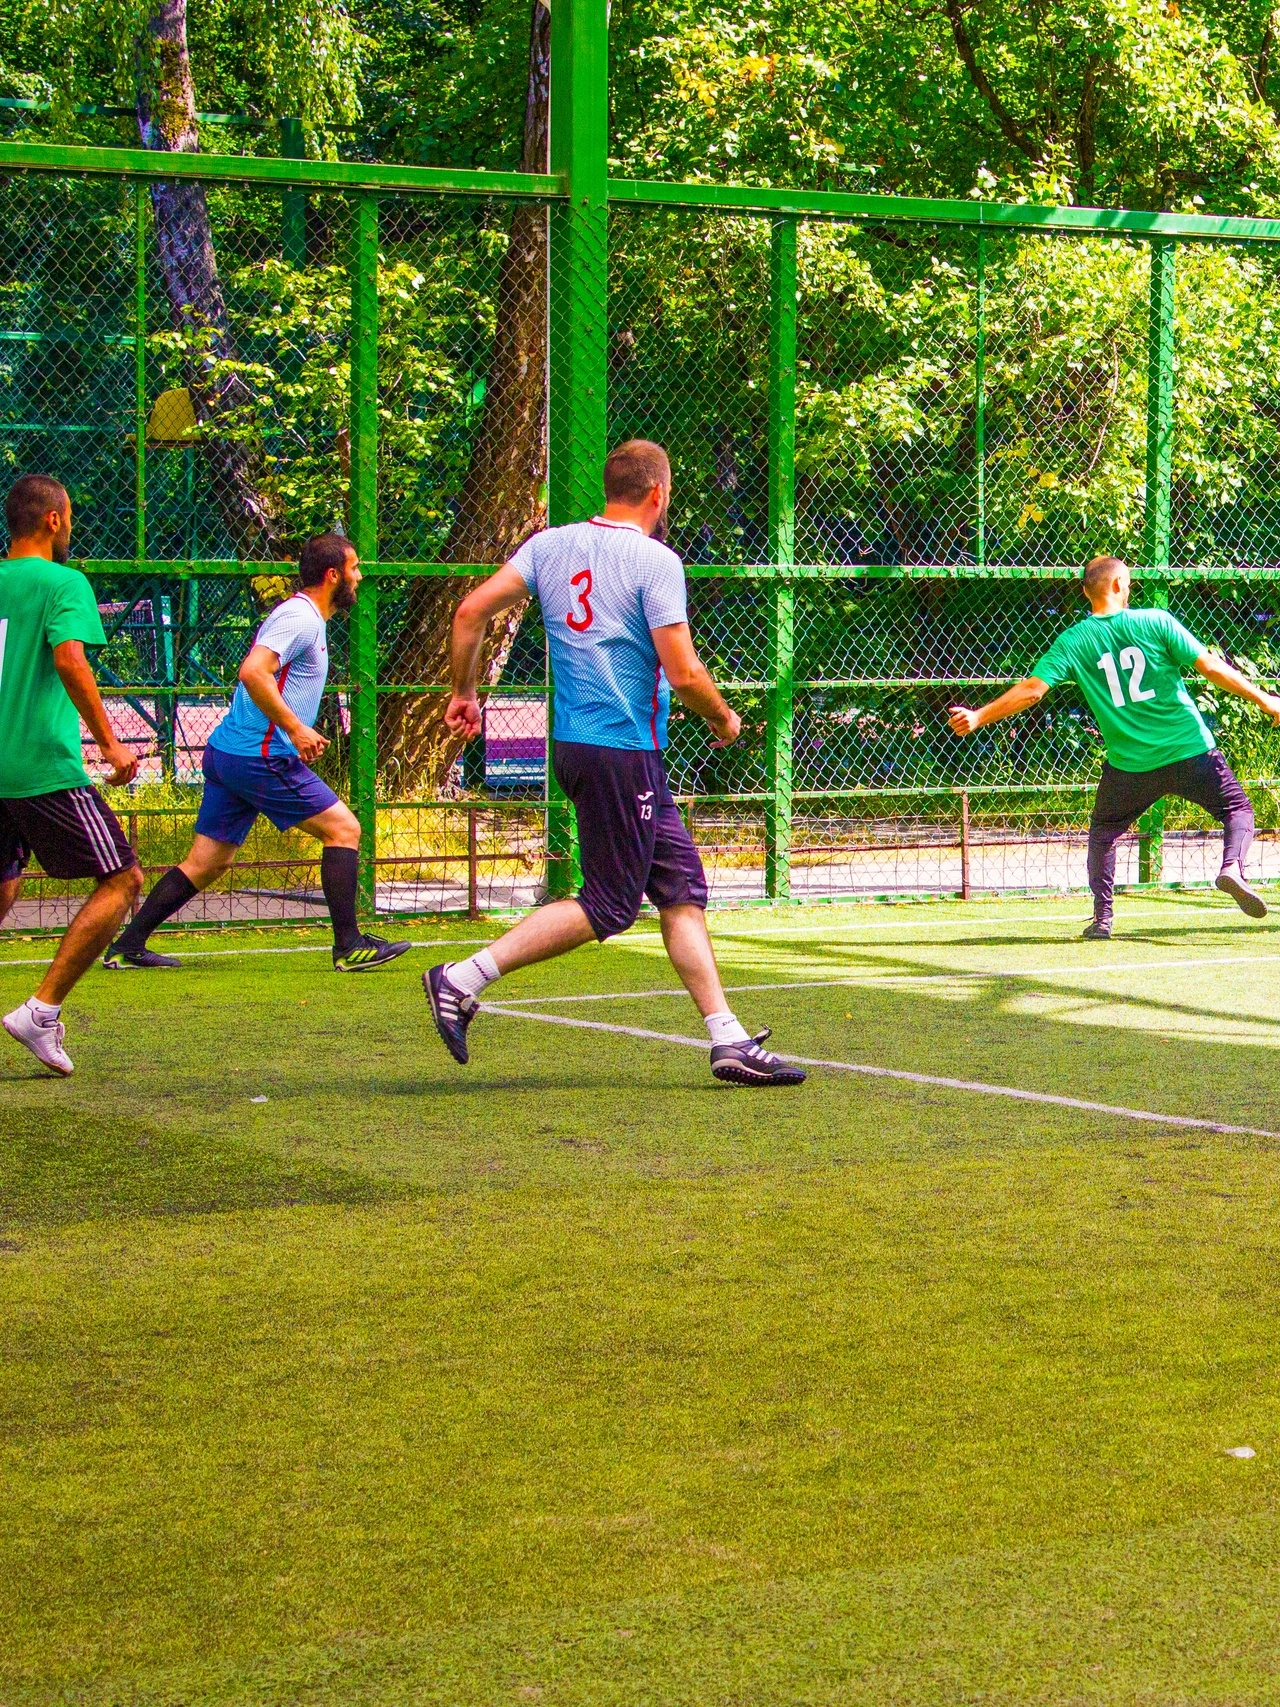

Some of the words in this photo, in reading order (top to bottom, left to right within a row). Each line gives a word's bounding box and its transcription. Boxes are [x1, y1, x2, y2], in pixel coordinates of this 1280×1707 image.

[566, 569, 593, 632] 3
[1096, 646, 1156, 708] 12
[640, 804, 652, 820] 13
